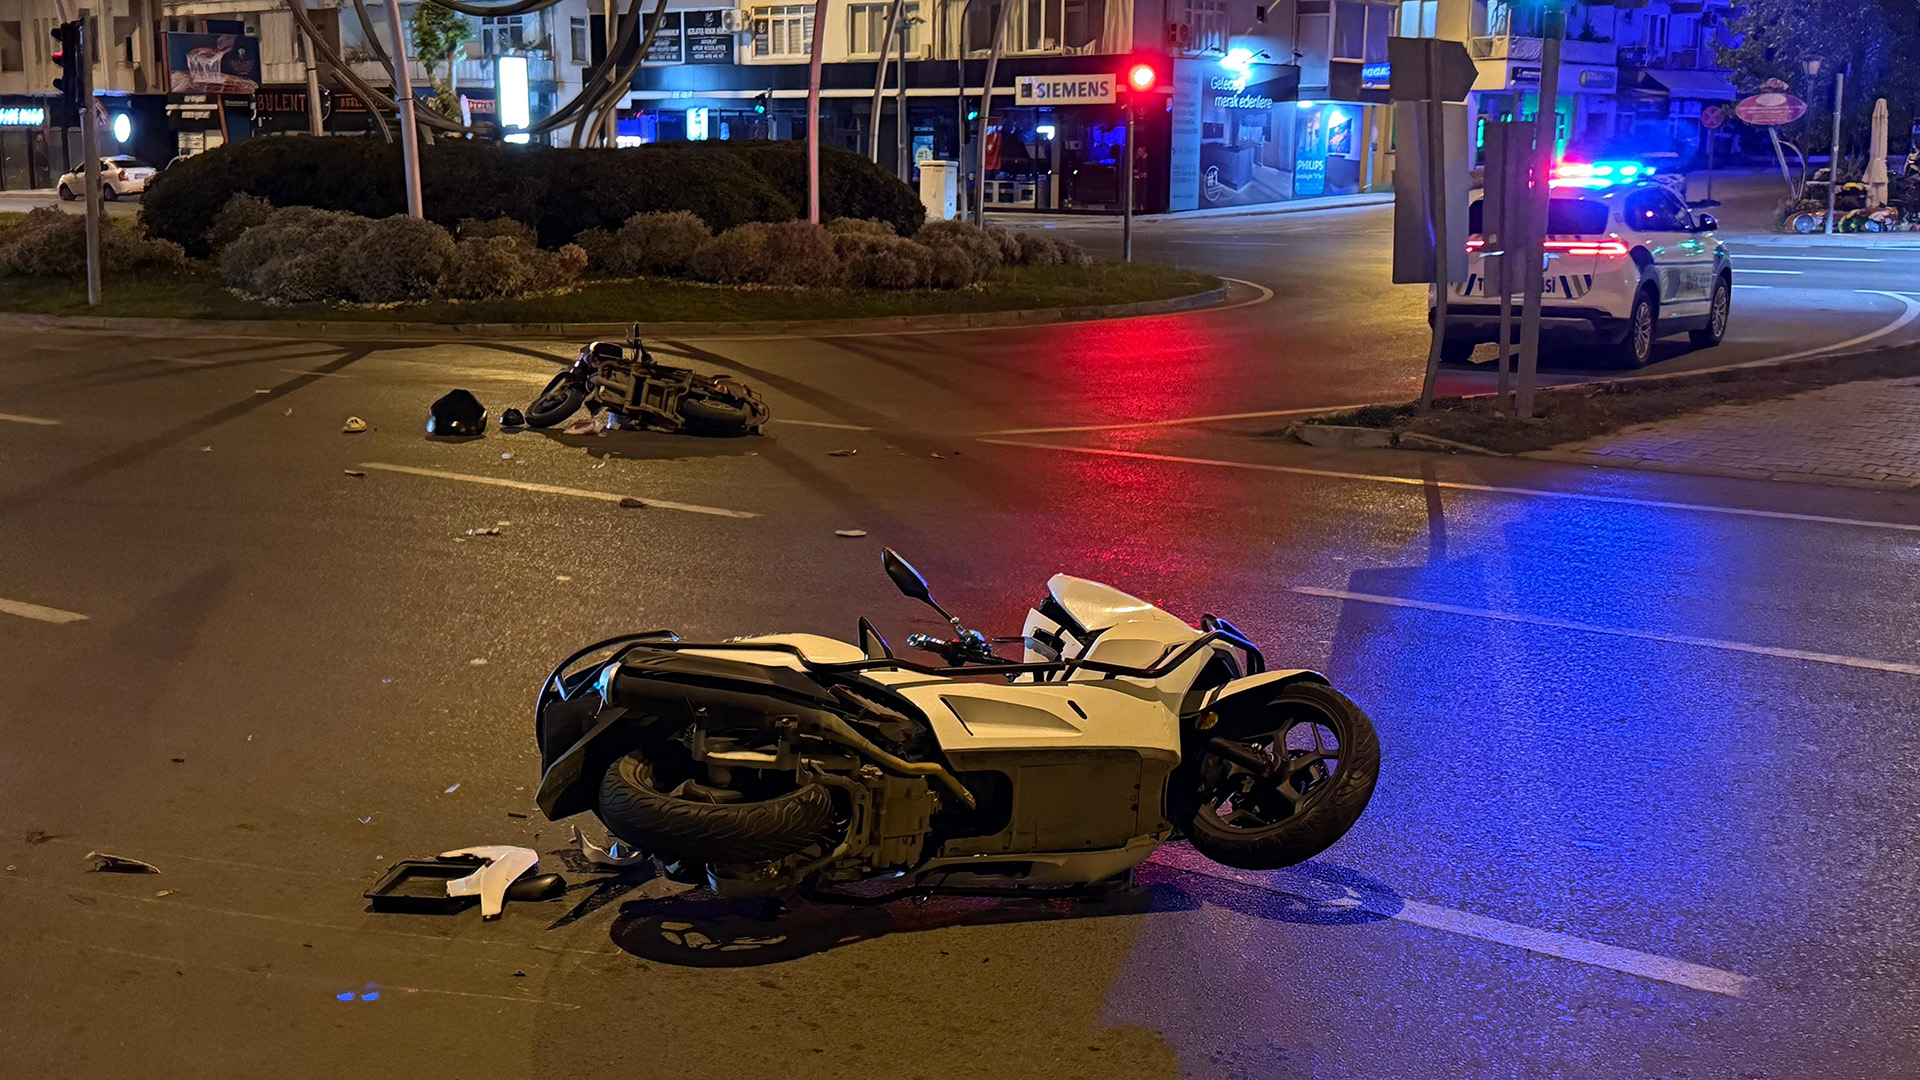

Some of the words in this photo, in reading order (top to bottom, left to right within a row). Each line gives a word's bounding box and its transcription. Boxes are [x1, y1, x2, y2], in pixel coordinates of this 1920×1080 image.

[1036, 81, 1109, 98] SIEMENS
[1297, 160, 1324, 171] PHILIPS
[1206, 169, 1219, 187] #1
